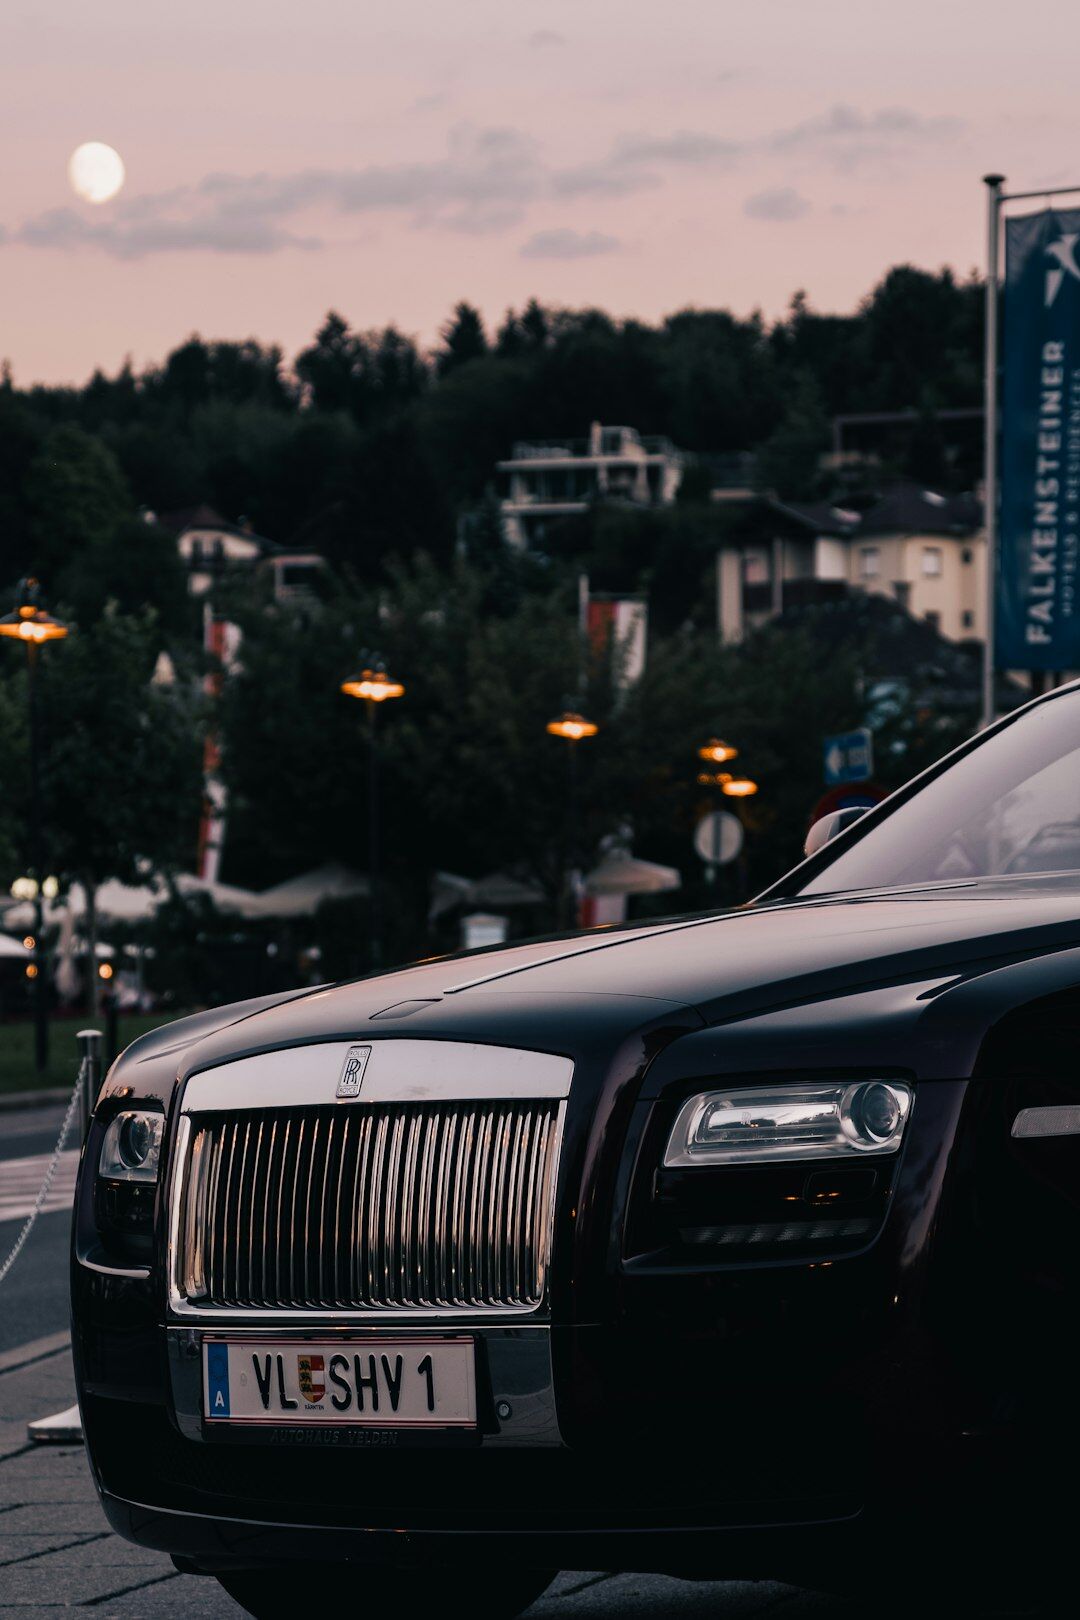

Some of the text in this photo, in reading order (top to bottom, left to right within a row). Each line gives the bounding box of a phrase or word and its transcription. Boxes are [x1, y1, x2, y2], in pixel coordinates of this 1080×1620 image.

[1026, 341, 1064, 643] FALKENSTEINER
[1061, 533, 1077, 617] HOTELS
[214, 1390, 225, 1407] A
[252, 1353, 435, 1412] VL SHV 1
[270, 1429, 398, 1445] AUTOHAUS VELDEN
